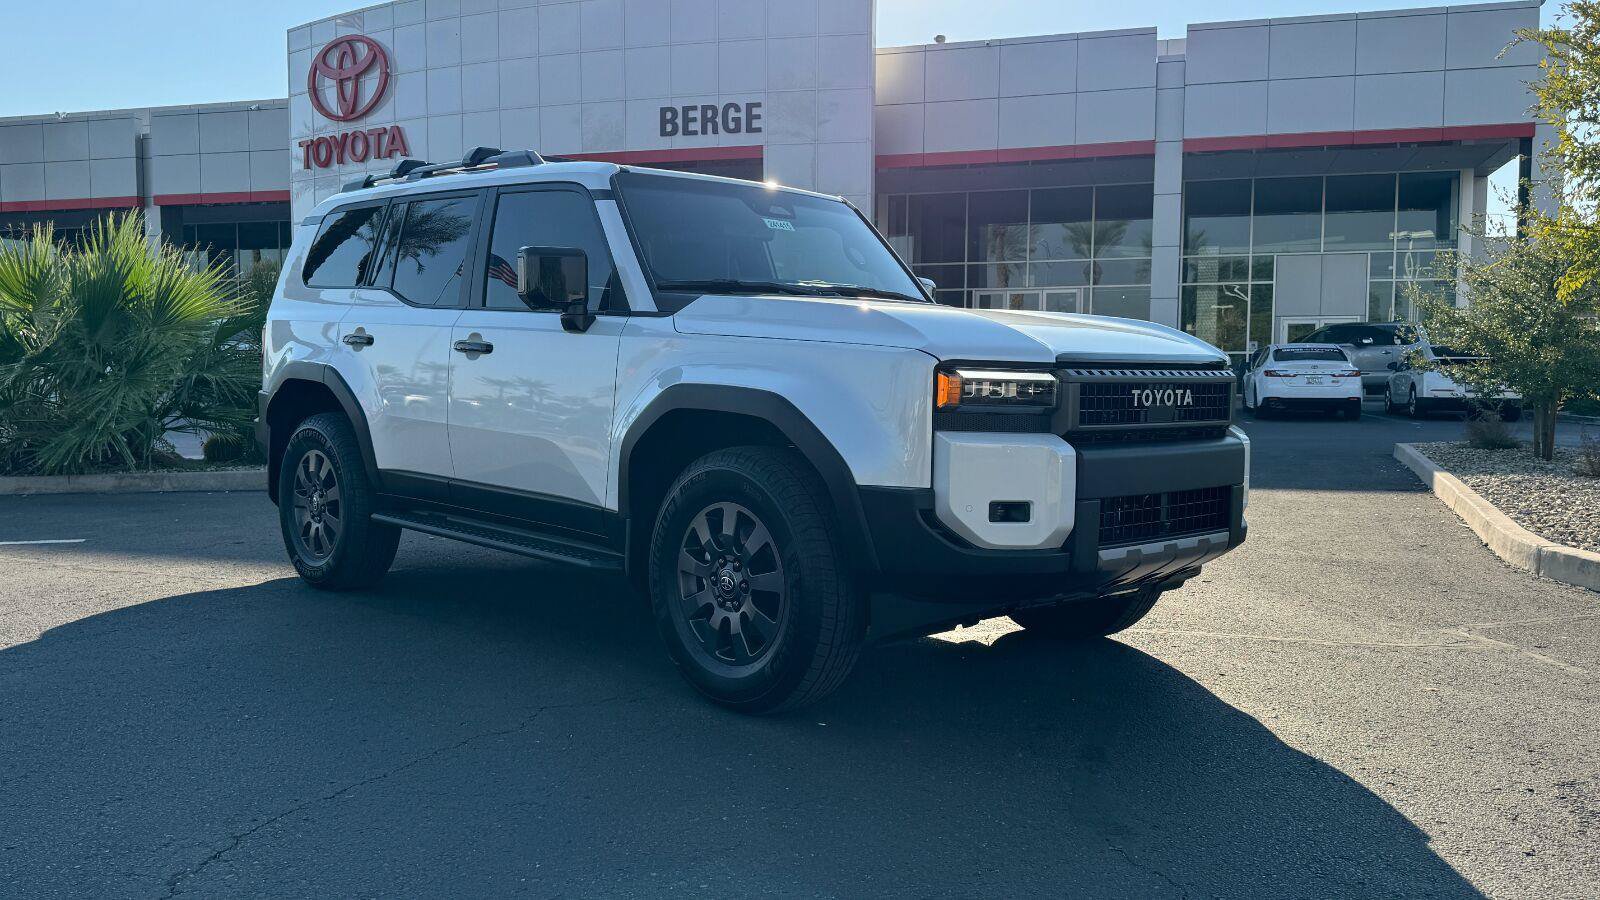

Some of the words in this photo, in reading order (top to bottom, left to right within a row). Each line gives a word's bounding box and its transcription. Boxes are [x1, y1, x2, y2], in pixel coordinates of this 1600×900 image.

[659, 101, 763, 137] BERGE
[298, 125, 410, 169] TOYOTA
[1131, 389, 1193, 407] TOYOTA
